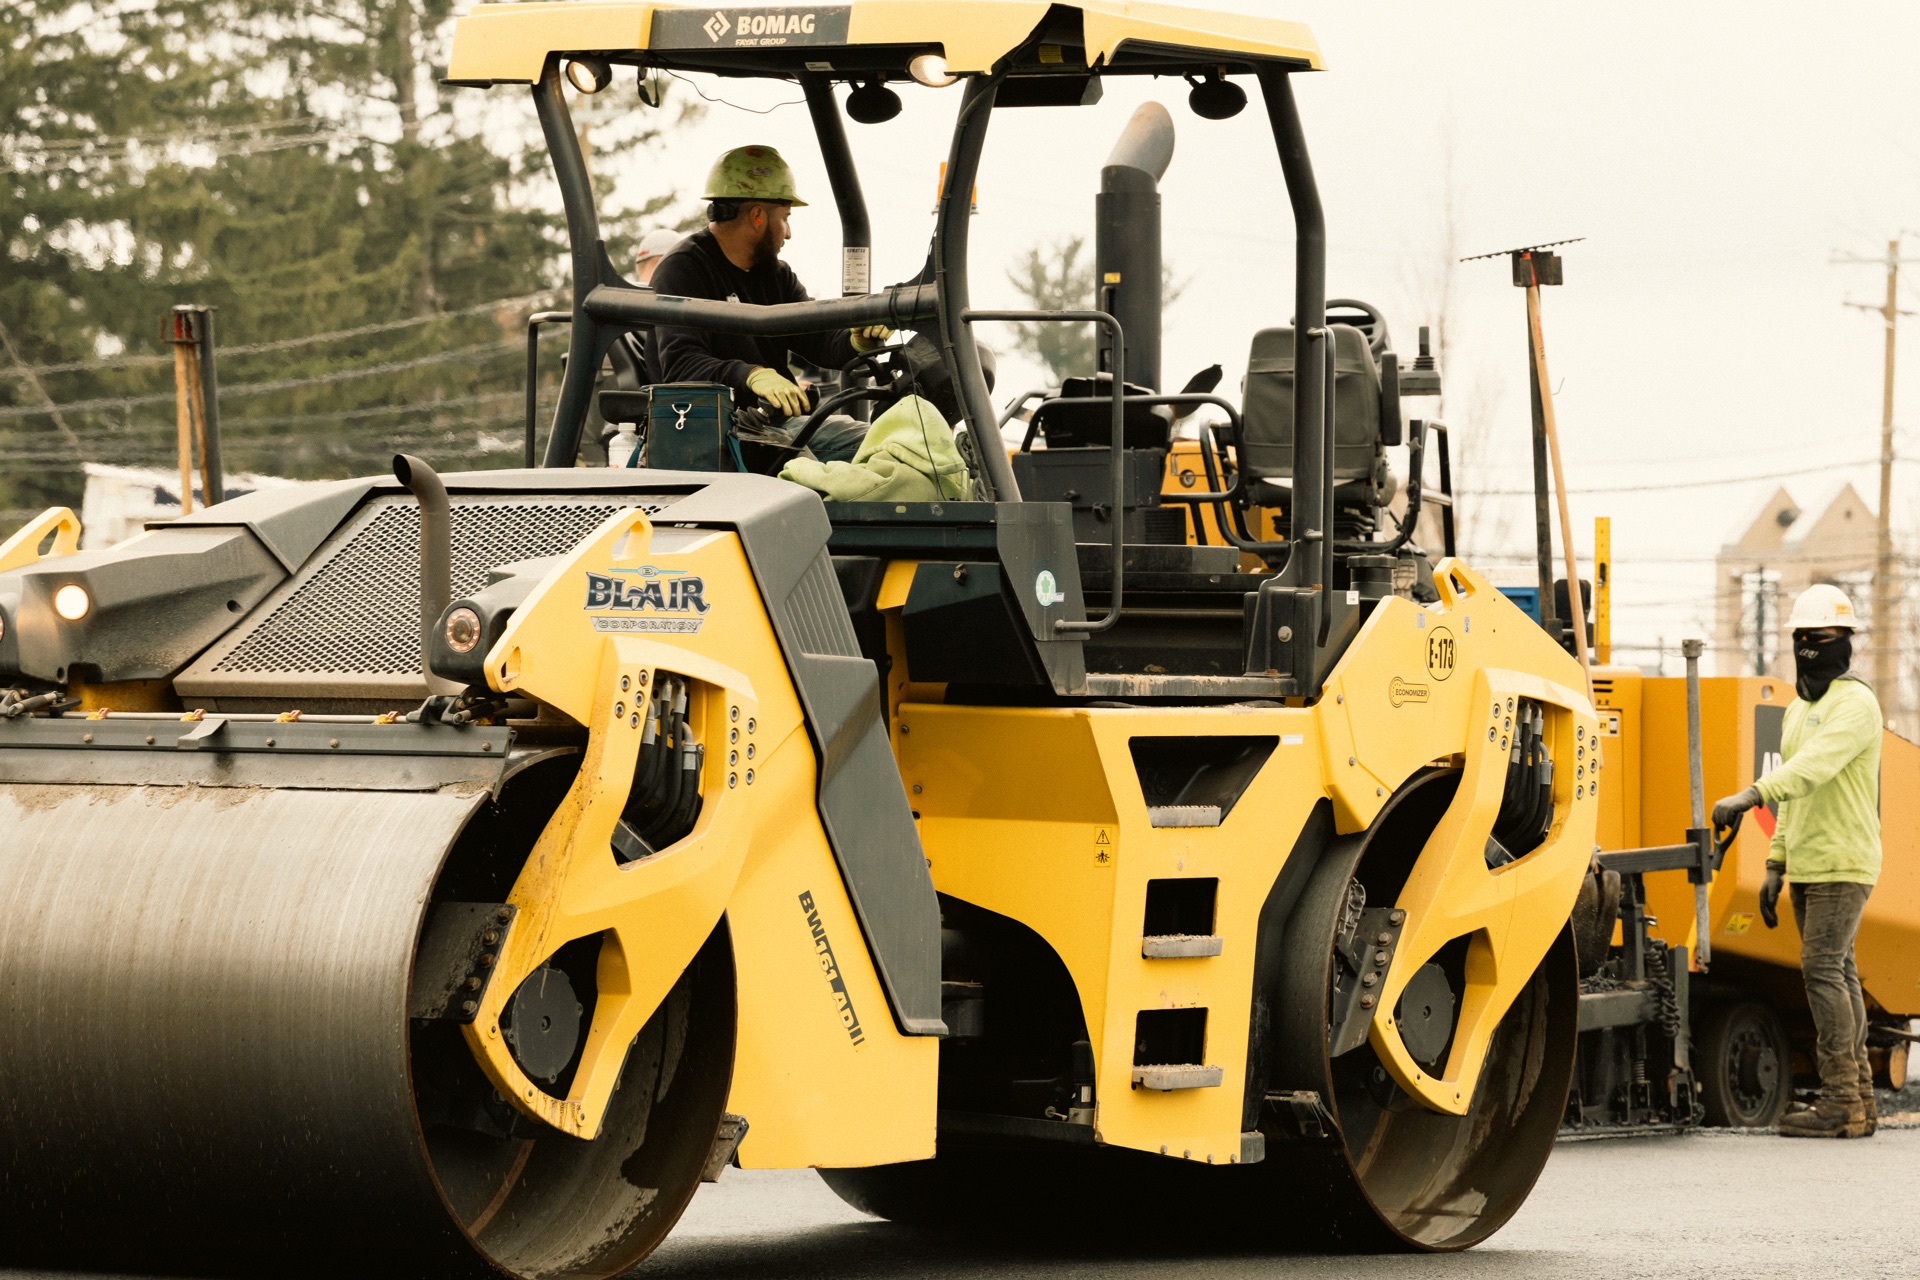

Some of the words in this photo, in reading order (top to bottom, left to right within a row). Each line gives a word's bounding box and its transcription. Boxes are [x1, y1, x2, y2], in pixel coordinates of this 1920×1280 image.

[737, 13, 815, 36] BOMAG
[735, 38, 758, 46] FAYAT
[760, 37, 787, 46] GROUP
[584, 571, 711, 615] BLAIR
[598, 619, 699, 631] CORPORATION
[1429, 637, 1454, 669] E-173
[1395, 688, 1428, 697] ECONOMIZER
